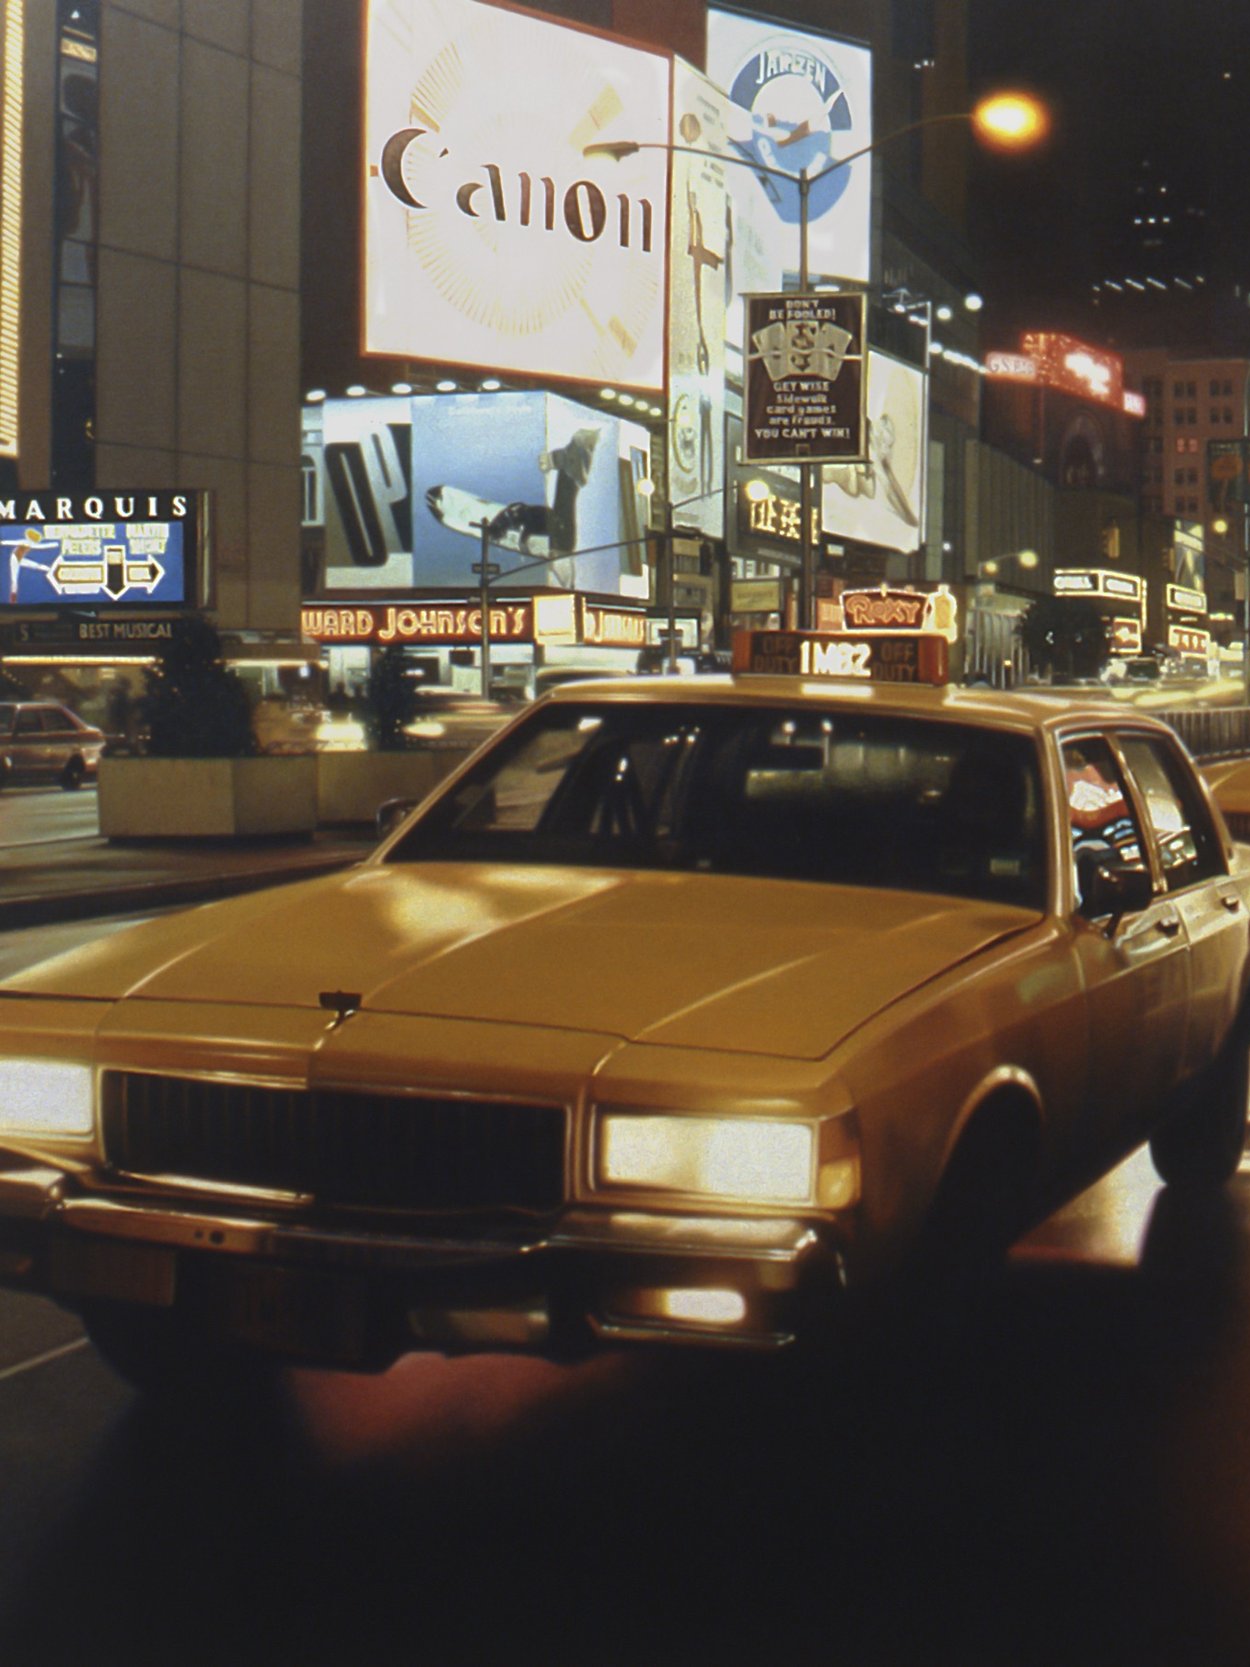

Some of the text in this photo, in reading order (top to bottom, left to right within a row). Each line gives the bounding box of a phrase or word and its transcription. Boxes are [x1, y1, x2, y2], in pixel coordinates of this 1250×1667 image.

[380, 128, 652, 252] Canon
[768, 309, 836, 320] BE FOOLED!
[801, 382, 830, 391] WISE
[766, 405, 796, 414] card
[768, 418, 790, 426] are
[755, 428, 850, 438] YOU CAN'T WIN!
[0, 496, 187, 520] MARQUIS
[79, 623, 110, 639] BEST
[882, 643, 914, 661] OFF
